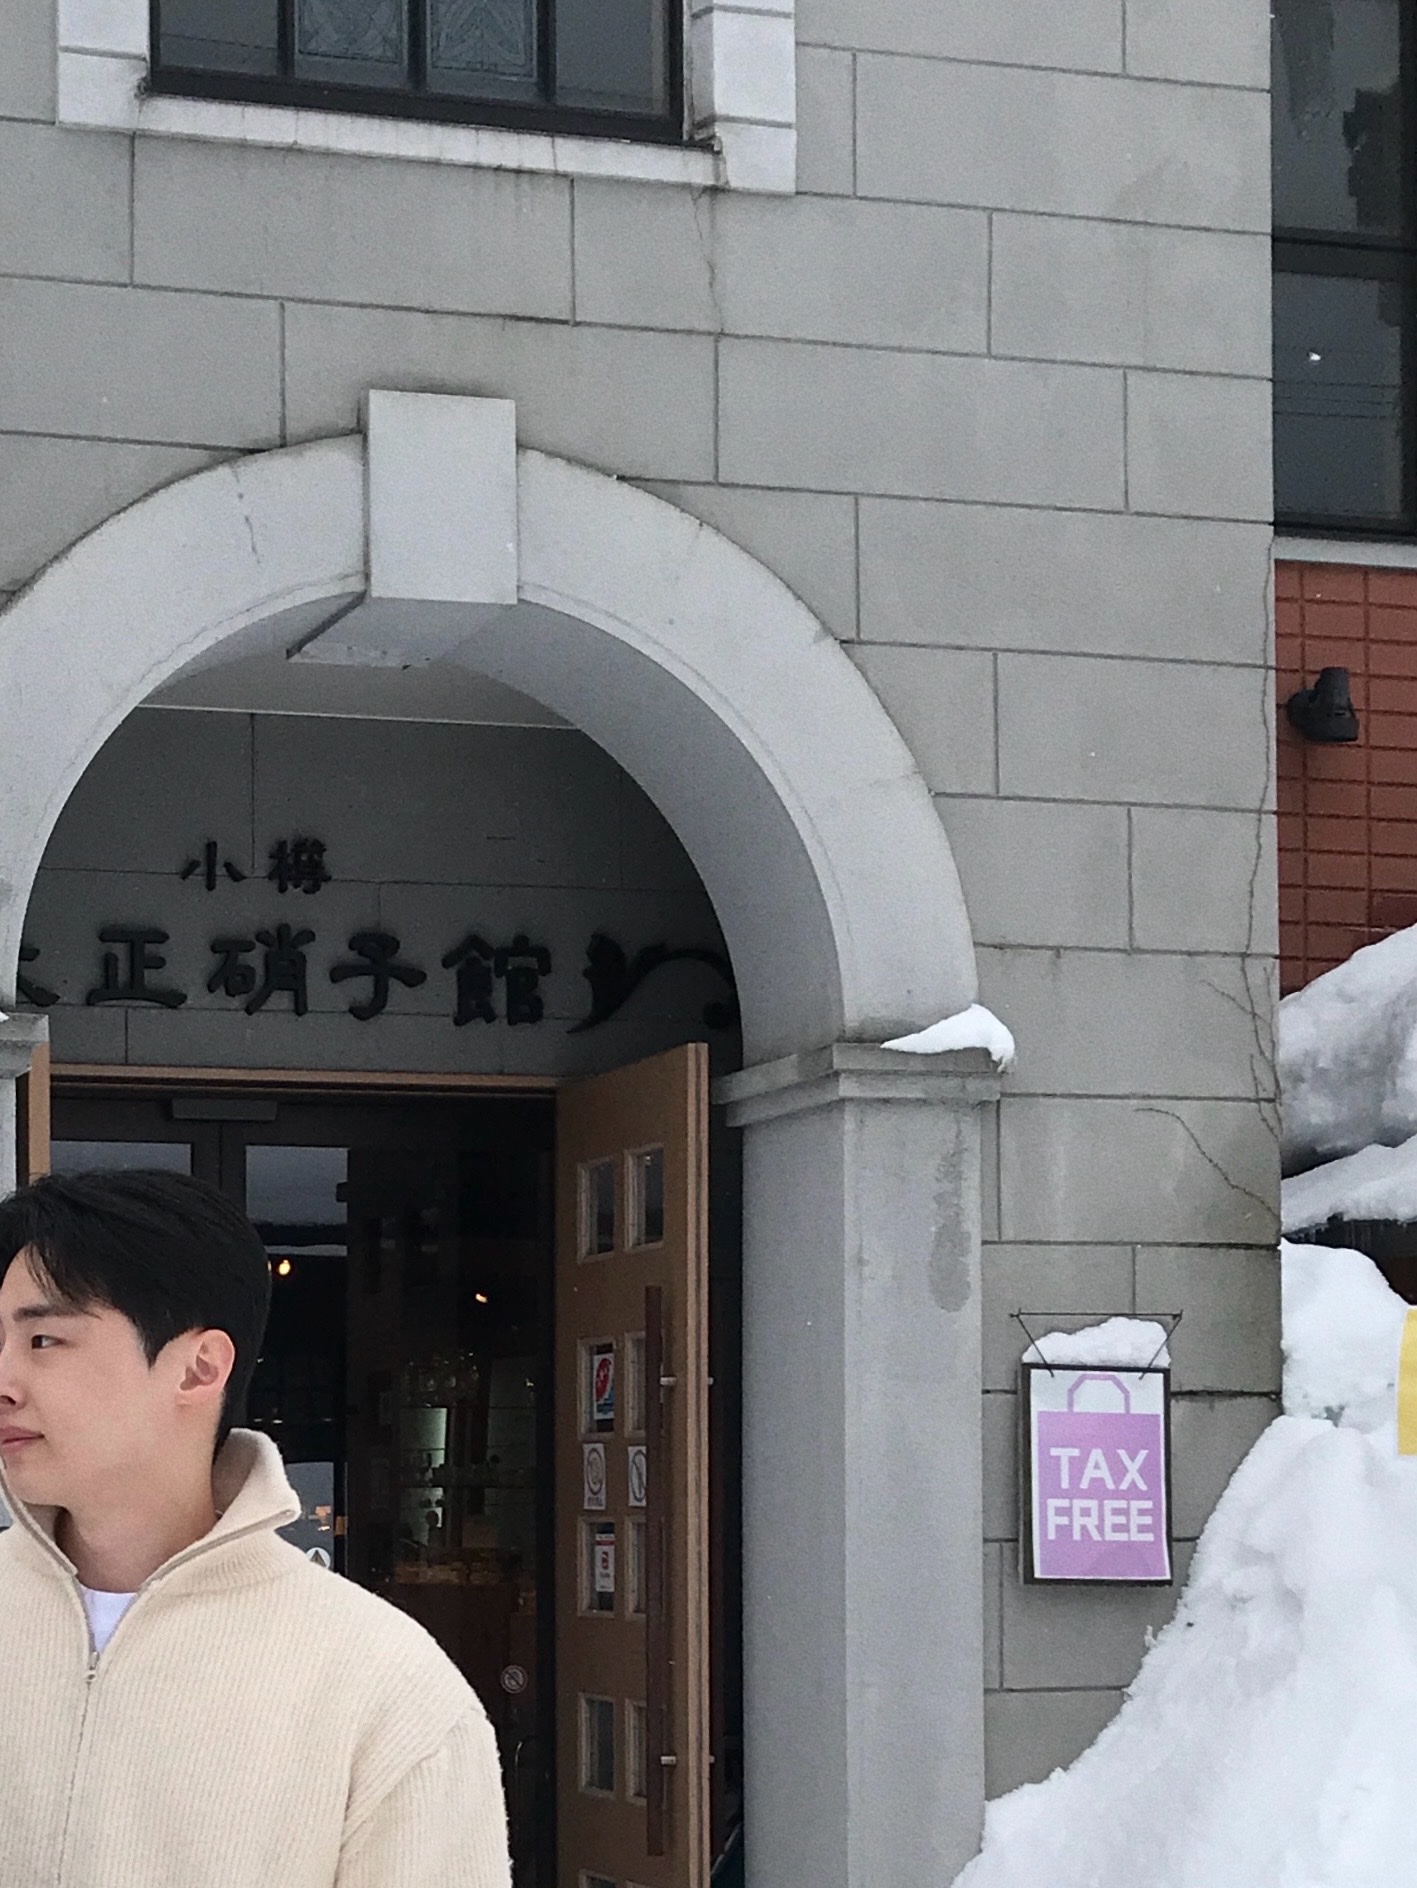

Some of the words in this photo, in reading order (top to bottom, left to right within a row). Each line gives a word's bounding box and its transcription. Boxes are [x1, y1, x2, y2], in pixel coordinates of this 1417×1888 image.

[183, 838, 332, 895] 小樽
[1049, 1447, 1150, 1491] TAX
[1046, 1498, 1155, 1543] FREE
